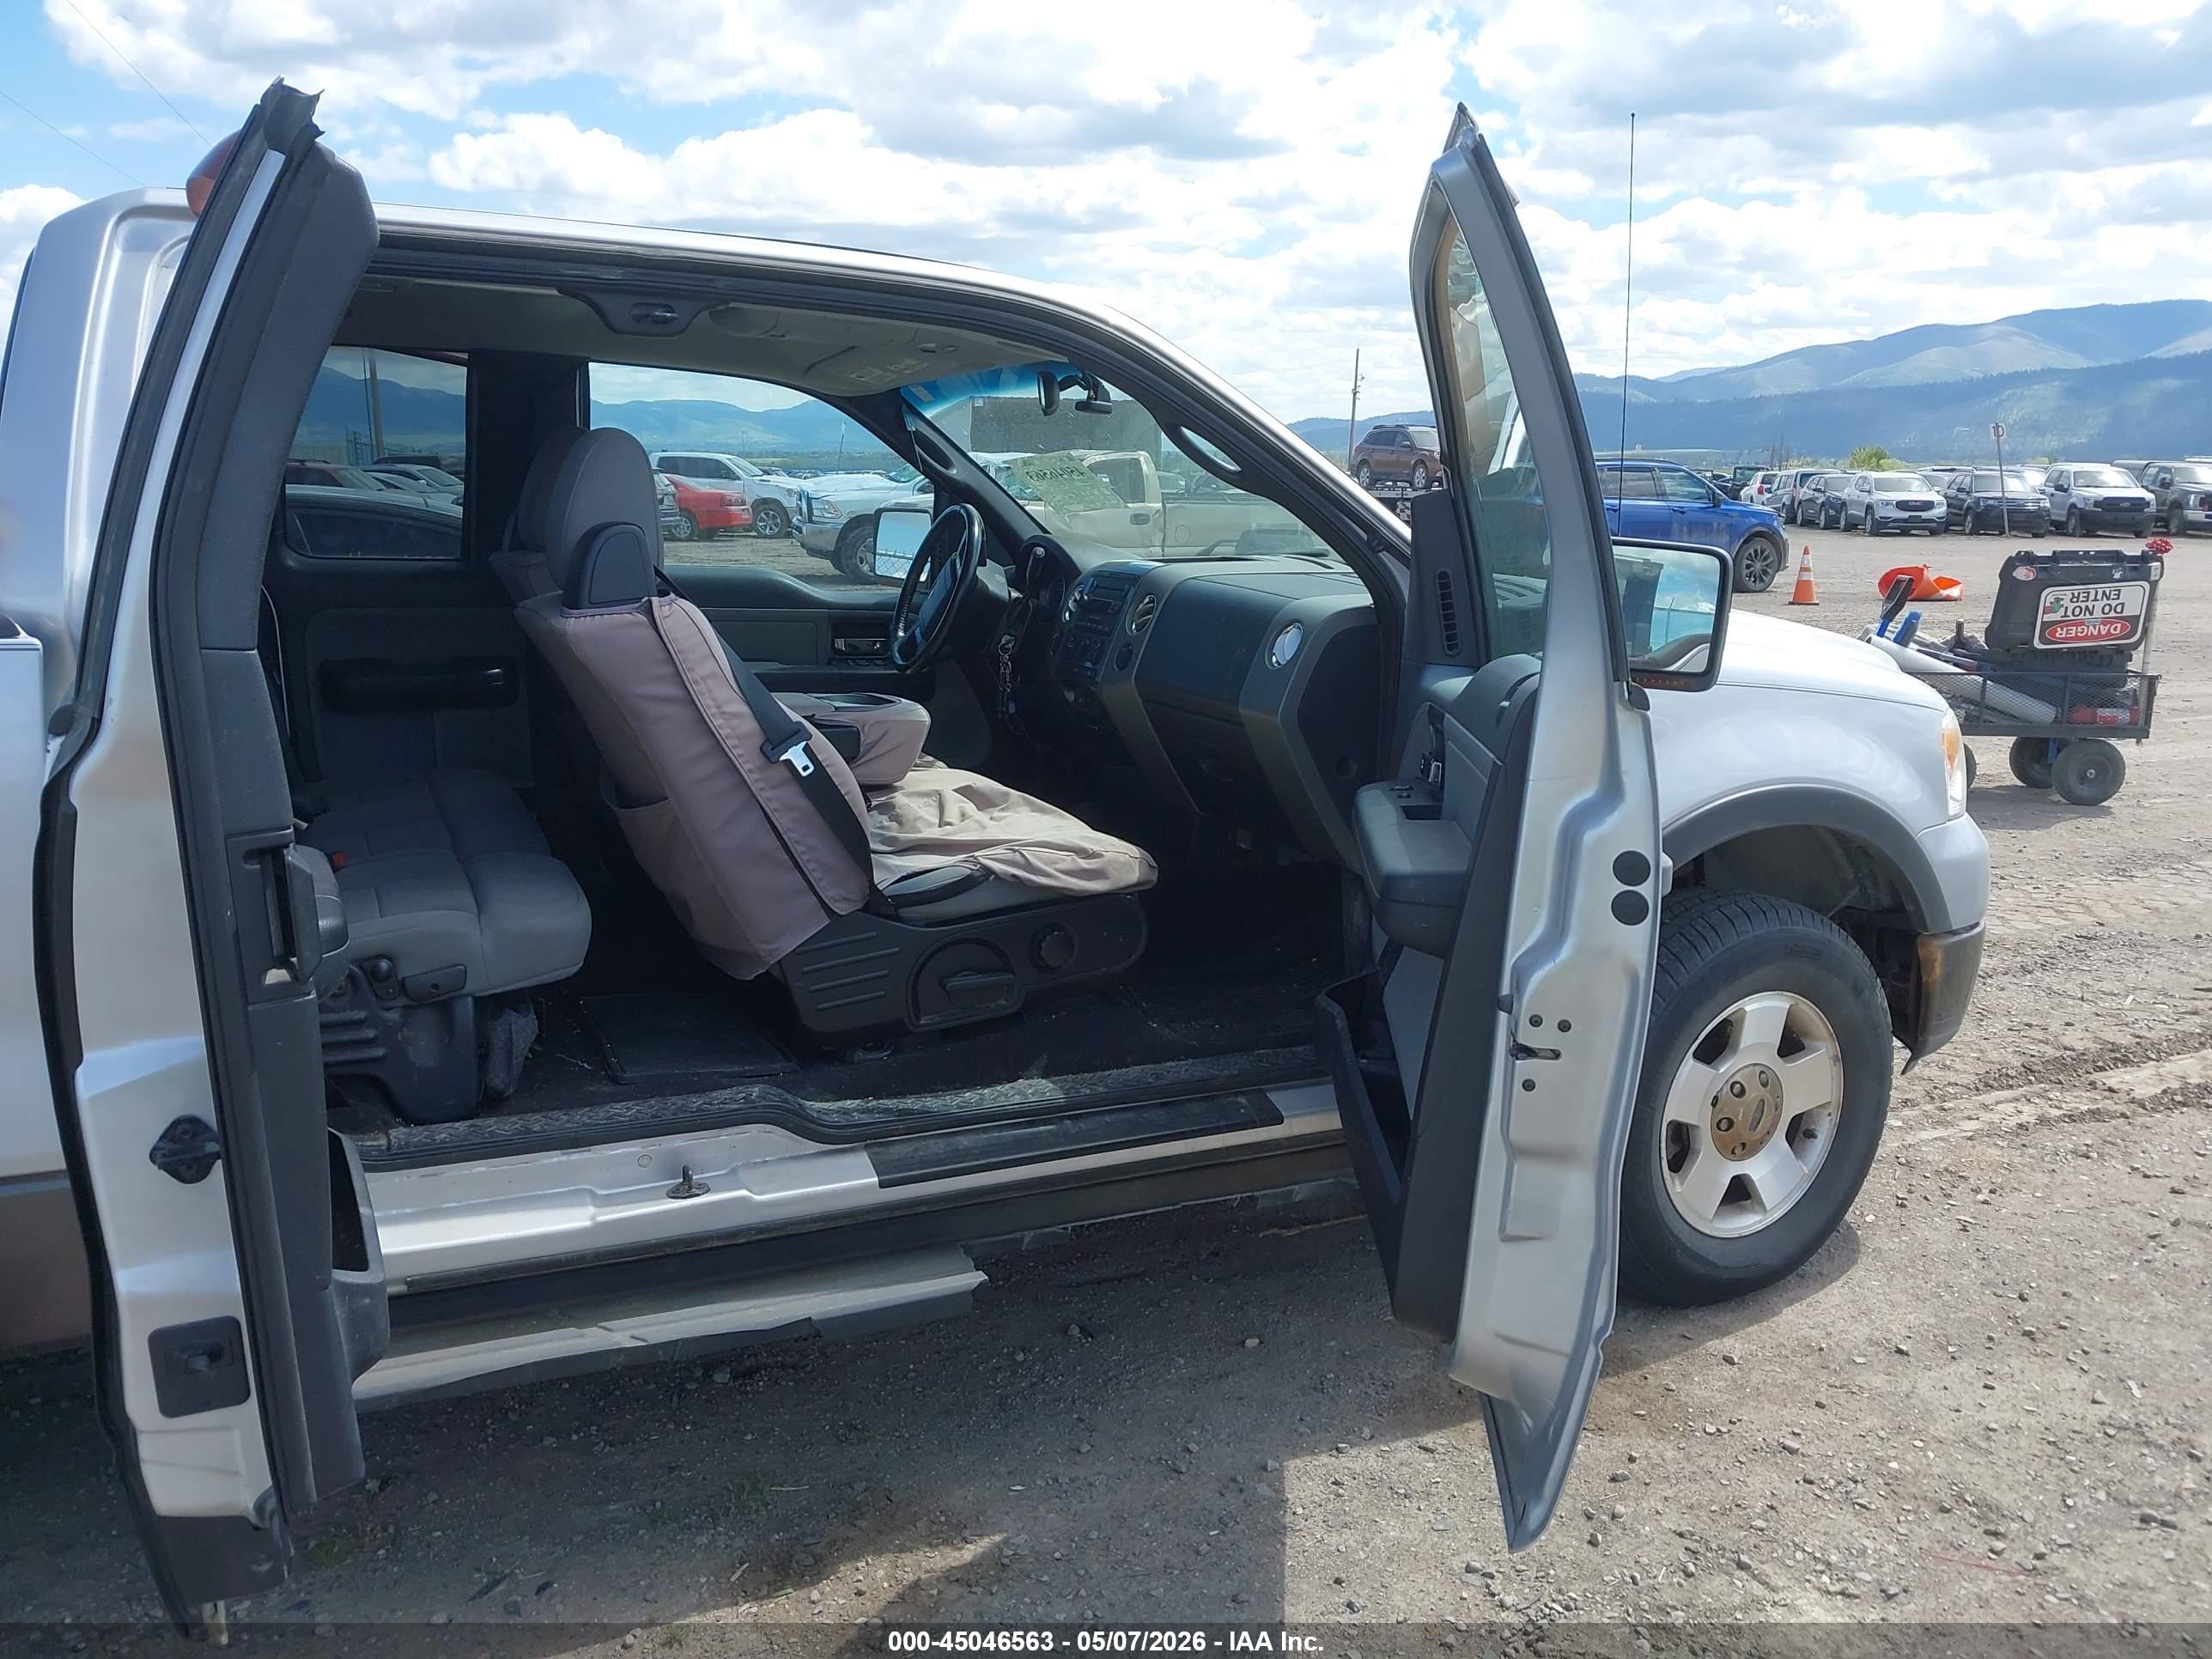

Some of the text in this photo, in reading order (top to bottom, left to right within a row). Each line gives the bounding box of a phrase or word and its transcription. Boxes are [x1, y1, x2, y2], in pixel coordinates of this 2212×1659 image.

[2069, 588, 2122, 603] ENTER
[2060, 602, 2125, 618] DO NOT
[2055, 623, 2122, 638] DANGER
